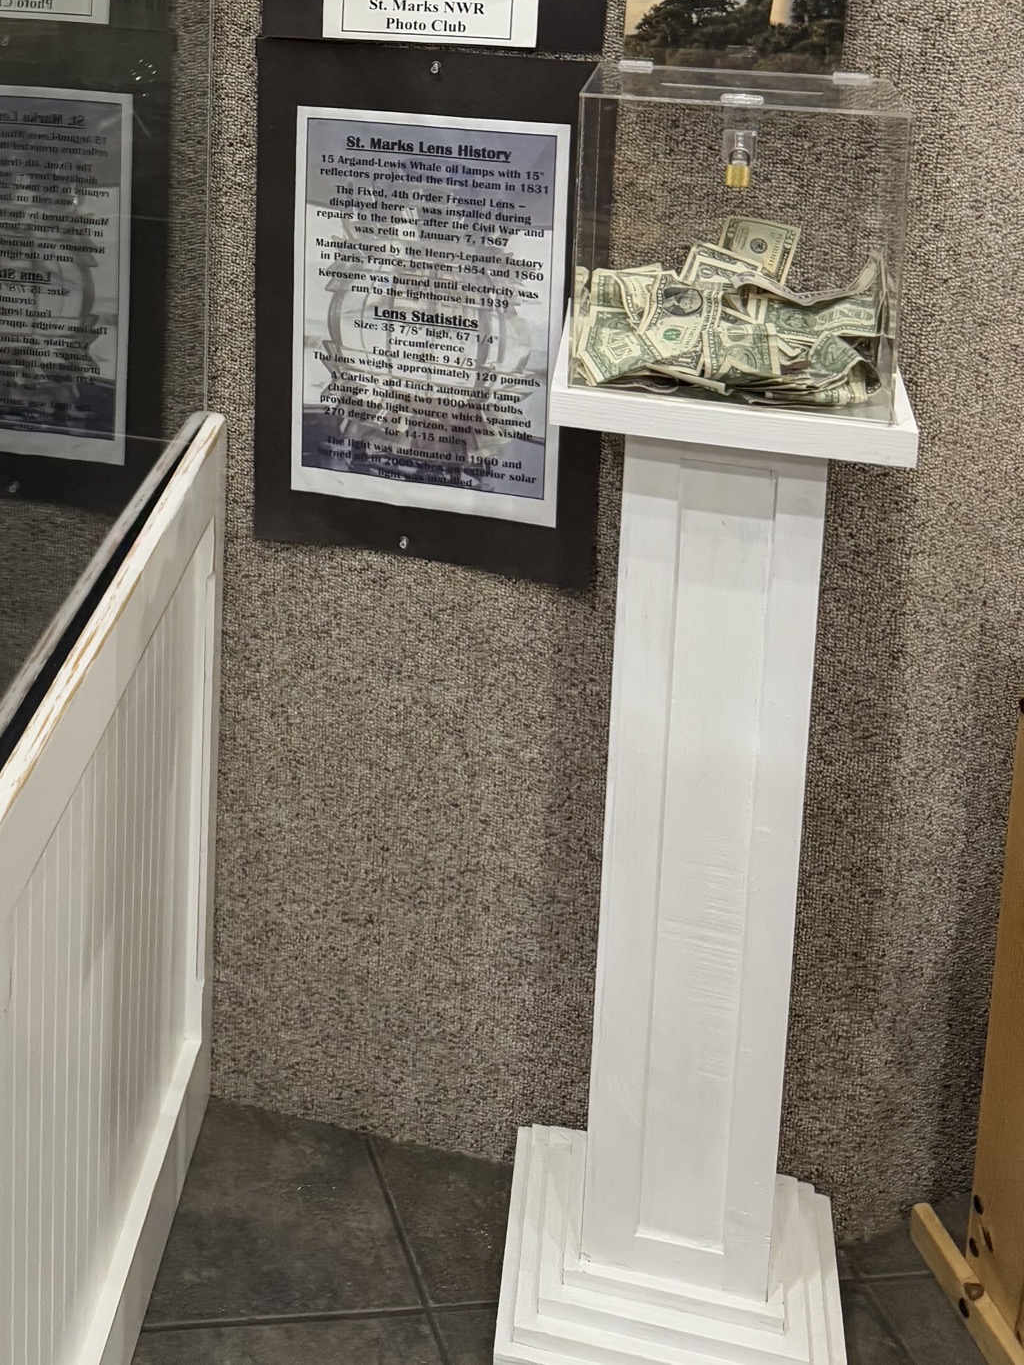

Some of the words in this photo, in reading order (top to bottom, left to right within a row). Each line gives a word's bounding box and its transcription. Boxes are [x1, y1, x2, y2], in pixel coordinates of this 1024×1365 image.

[393, 0, 439, 13] Marks
[444, 1, 484, 14] NWR
[386, 17, 426, 31] Photo
[431, 19, 466, 33] Club
[346, 135, 365, 148] St.
[370, 138, 414, 152] Marks
[419, 142, 452, 155] Lens
[458, 145, 511, 161] History
[322, 155, 334, 163] 15
[338, 155, 407, 169] Argand-Lewis
[410, 160, 441, 172] Whale
[445, 165, 458, 173] oil
[462, 165, 494, 177] lamps
[498, 169, 521, 179] with
[320, 167, 370, 178] reflectors
[373, 172, 422, 182] projected
[426, 176, 442, 184] the
[446, 178, 468, 187] first
[472, 180, 501, 190] beam
[505, 182, 515, 191] in
[520, 183, 548, 194] 1831
[336, 185, 354, 194] The
[358, 187, 387, 198] Fixed,
[391, 190, 409, 199] 4th
[412, 191, 443, 202] Order
[446, 194, 486, 206] Fresnel
[490, 199, 515, 209] Lens
[316, 238, 386, 253] Manufactured
[390, 244, 402, 255] by
[405, 247, 421, 255] the
[425, 248, 502, 264] Henry-Lepaute
[506, 257, 544, 270] factory
[320, 251, 330, 260] in
[334, 252, 364, 264] Paris,
[367, 255, 406, 267] France,
[410, 260, 452, 272] between
[458, 265, 485, 275] 1854
[490, 269, 510, 278] and
[515, 271, 544, 281] 1860
[373, 306, 407, 321] Lens
[412, 310, 478, 328] Statistics
[354, 320, 378, 330] Size:
[381, 323, 395, 332] 35
[426, 328, 452, 339] high,
[456, 331, 470, 341] 67
[389, 336, 464, 353] circumference
